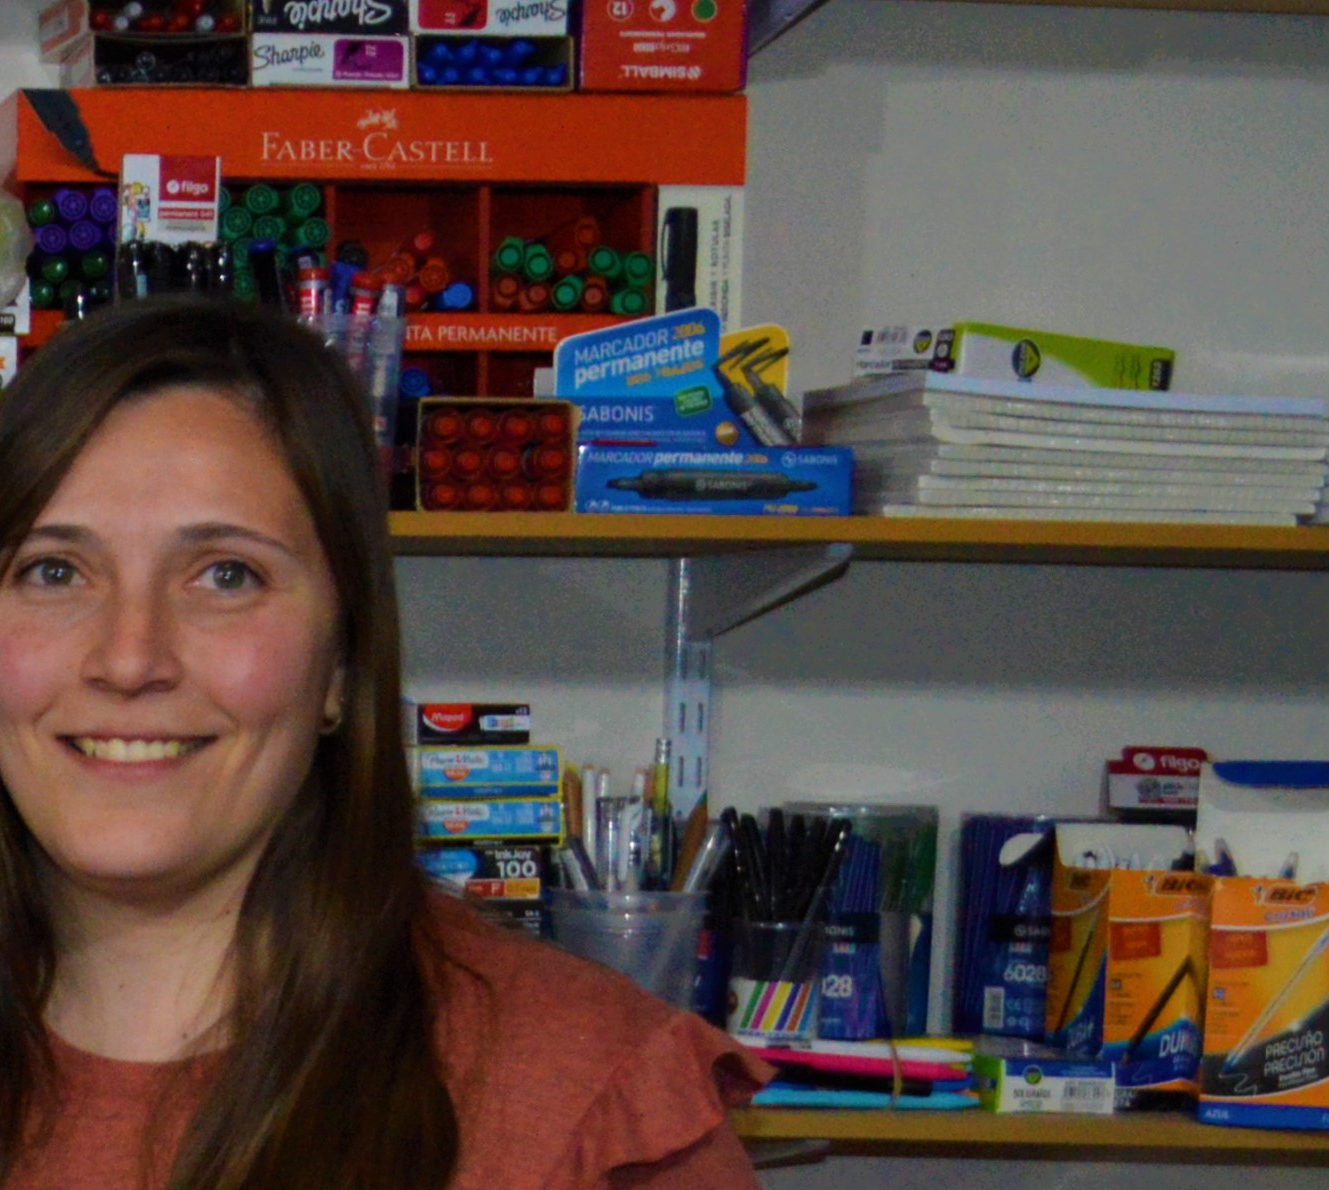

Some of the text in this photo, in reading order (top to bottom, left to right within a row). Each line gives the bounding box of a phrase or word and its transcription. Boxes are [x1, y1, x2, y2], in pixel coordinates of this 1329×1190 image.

[253, 42, 325, 70] Sharpie
[623, 65, 685, 78] SIMBALL
[260, 132, 493, 163] FABER-CASTELL
[181, 179, 208, 194] filgo
[438, 326, 557, 343] PERMANENTE
[574, 322, 705, 363] MARCADOR 2006
[575, 338, 705, 389] permanente
[579, 405, 654, 422] SABONIS
[589, 451, 652, 465] MARCADOR
[654, 452, 743, 466] permanente
[796, 456, 838, 465] SABONIS
[431, 712, 464, 724] Maped
[1160, 755, 1199, 772] filgo
[497, 861, 537, 878] 100
